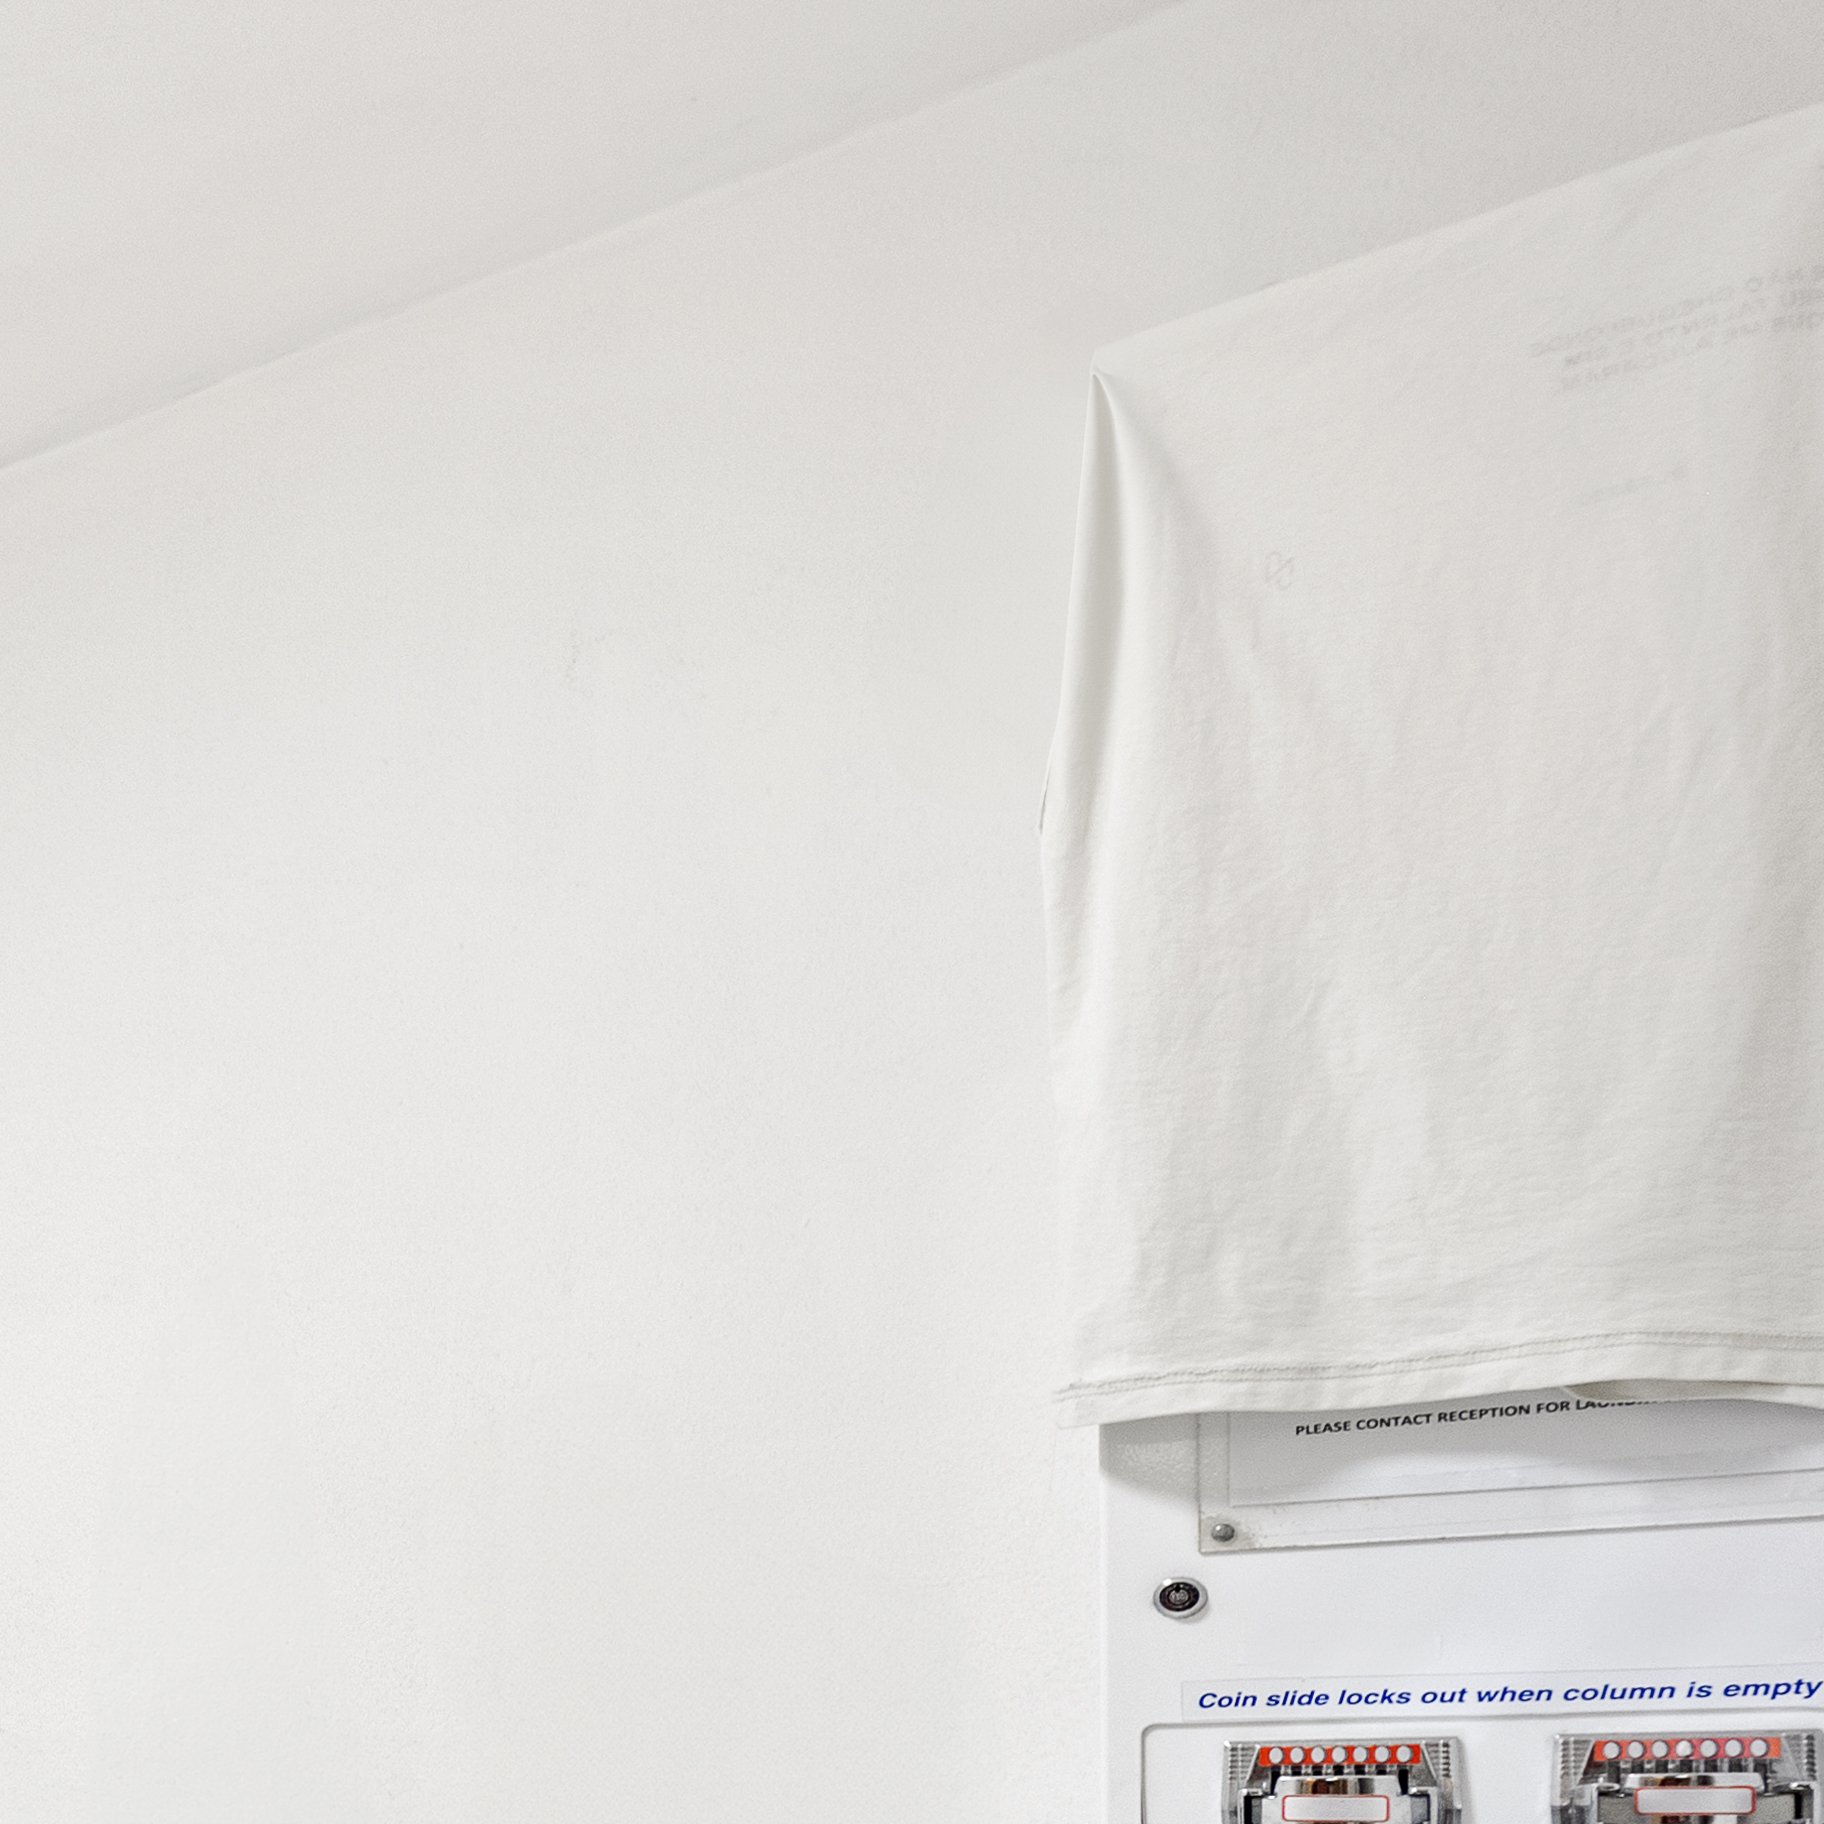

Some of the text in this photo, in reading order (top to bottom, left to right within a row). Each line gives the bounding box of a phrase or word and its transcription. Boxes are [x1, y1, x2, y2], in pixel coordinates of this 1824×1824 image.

[1295, 1420, 1351, 1436] PLEASE
[1355, 1413, 1433, 1431] CONTACT
[1438, 1404, 1531, 1424] RECEPTION
[1536, 1400, 1570, 1414] FOR
[1198, 1679, 1823, 1709] Coin slide locks out when column is empty
